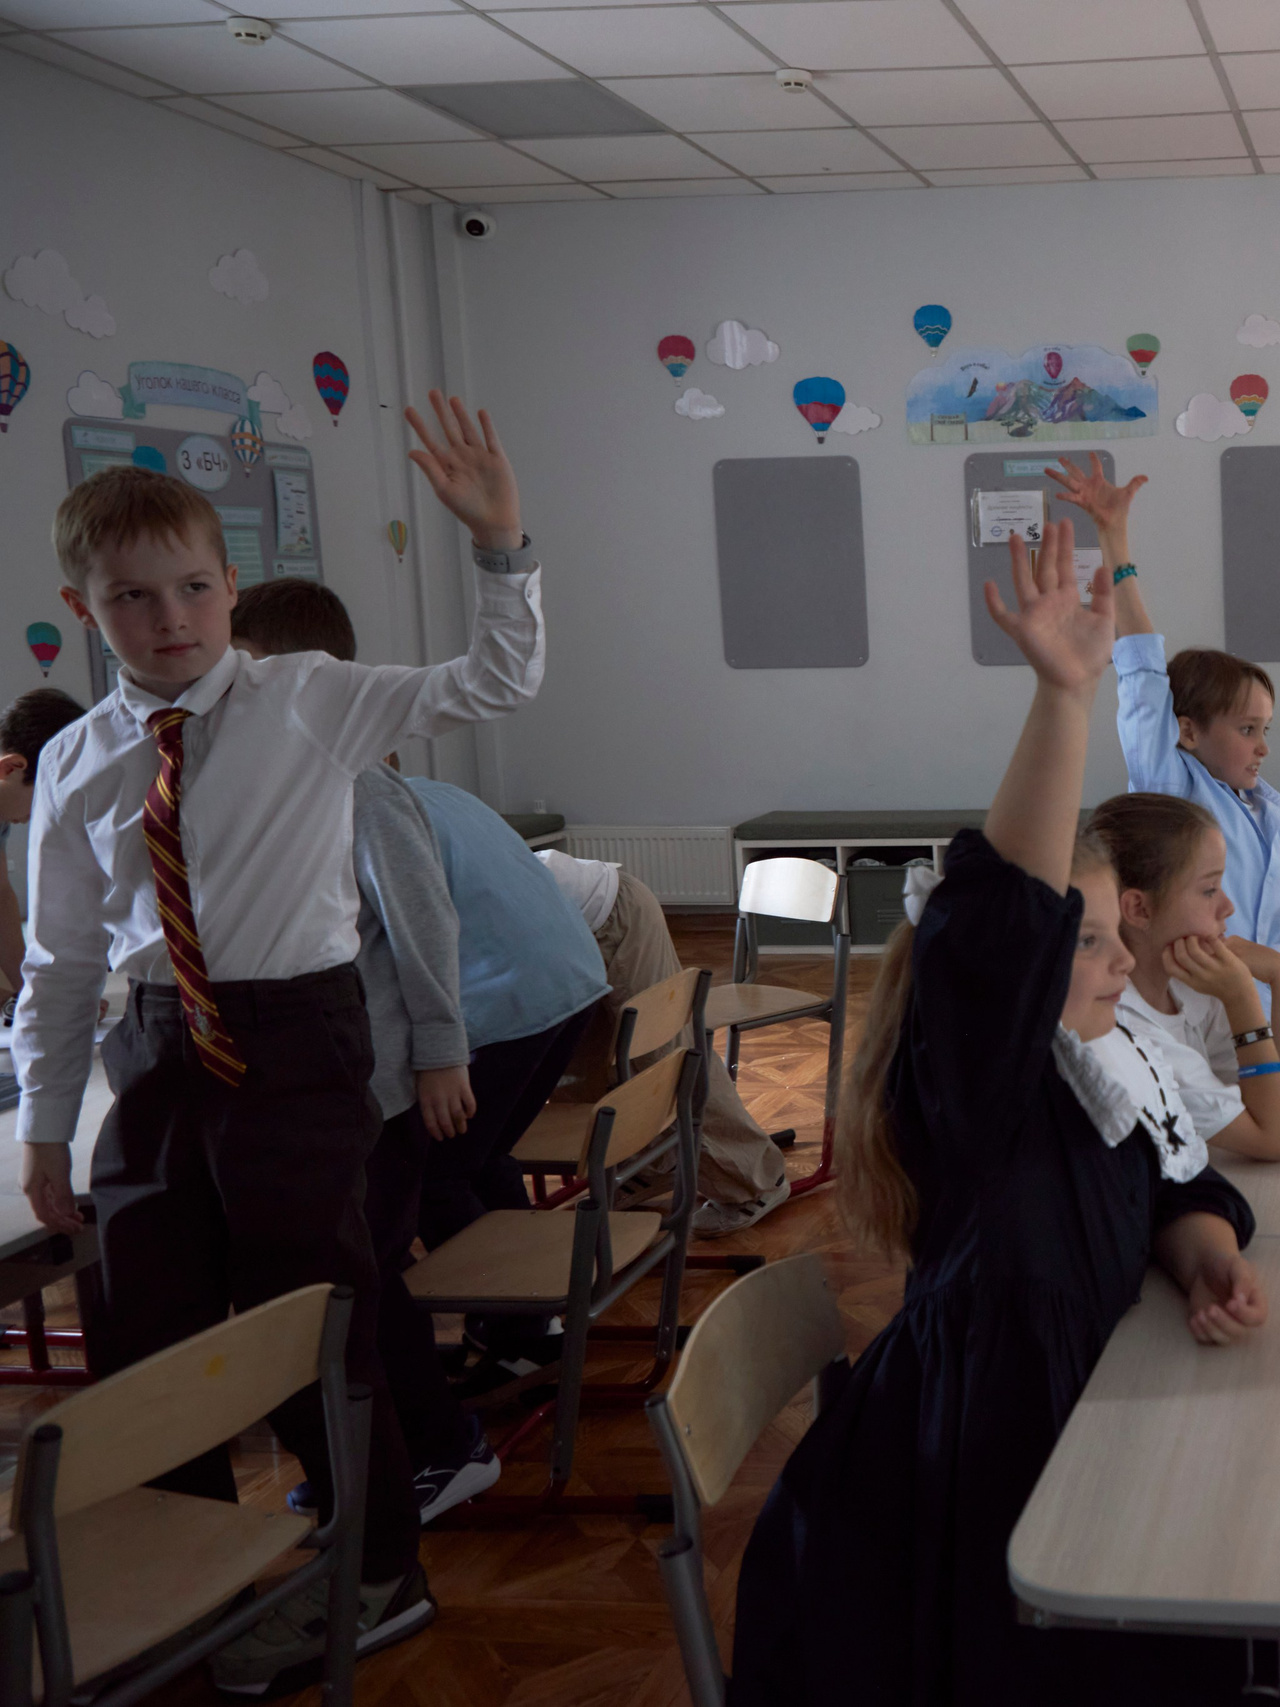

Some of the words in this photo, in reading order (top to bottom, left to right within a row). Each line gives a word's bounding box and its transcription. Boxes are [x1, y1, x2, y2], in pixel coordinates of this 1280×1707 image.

[134, 374, 173, 391] Уголок
[175, 378, 210, 394] нашего
[211, 385, 241, 404] класса
[181, 450, 191, 470] 3
[196, 451, 228, 472] «БЧ»
